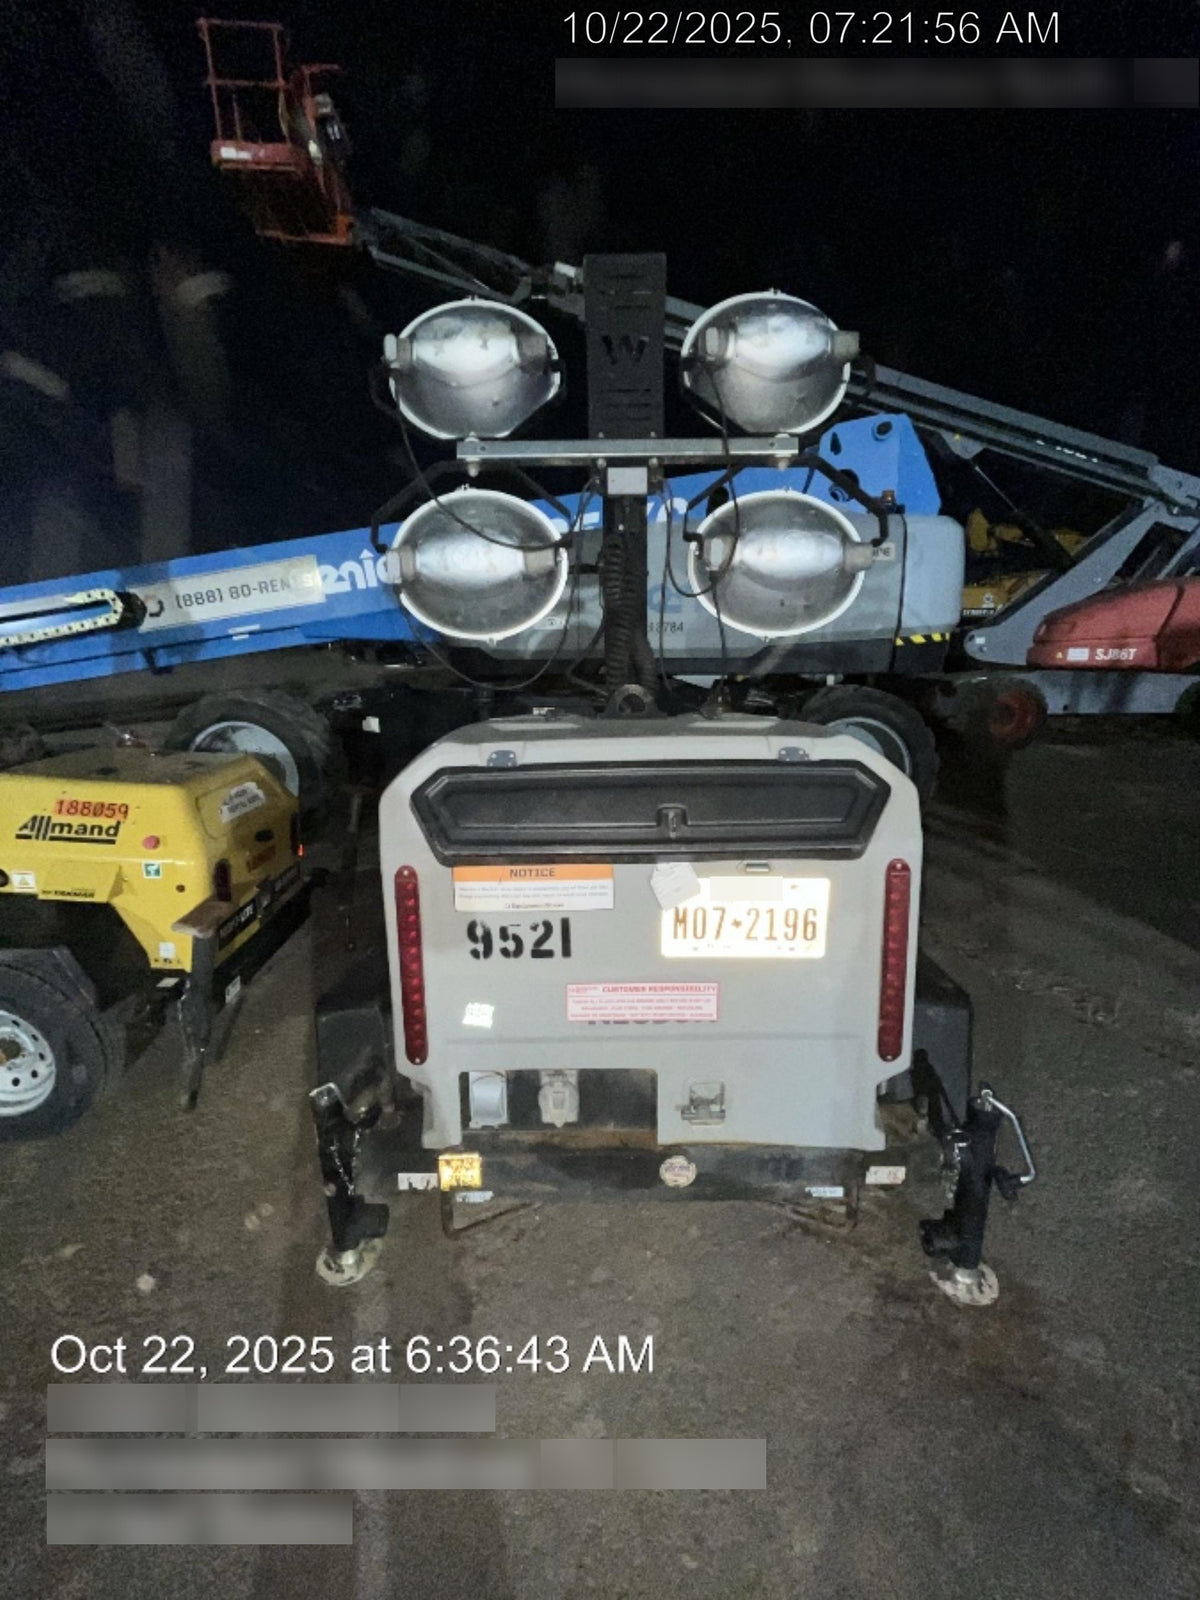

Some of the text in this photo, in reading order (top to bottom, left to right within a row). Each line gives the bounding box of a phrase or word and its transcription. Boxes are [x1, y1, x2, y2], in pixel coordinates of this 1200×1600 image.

[175, 588, 223, 609] (888)
[56, 799, 129, 820] 188059
[17, 814, 122, 842] Allmand
[509, 867, 557, 879] NOTICE
[468, 919, 571, 959] 9521
[648, 984, 717, 994] RESPONSIBILITY
